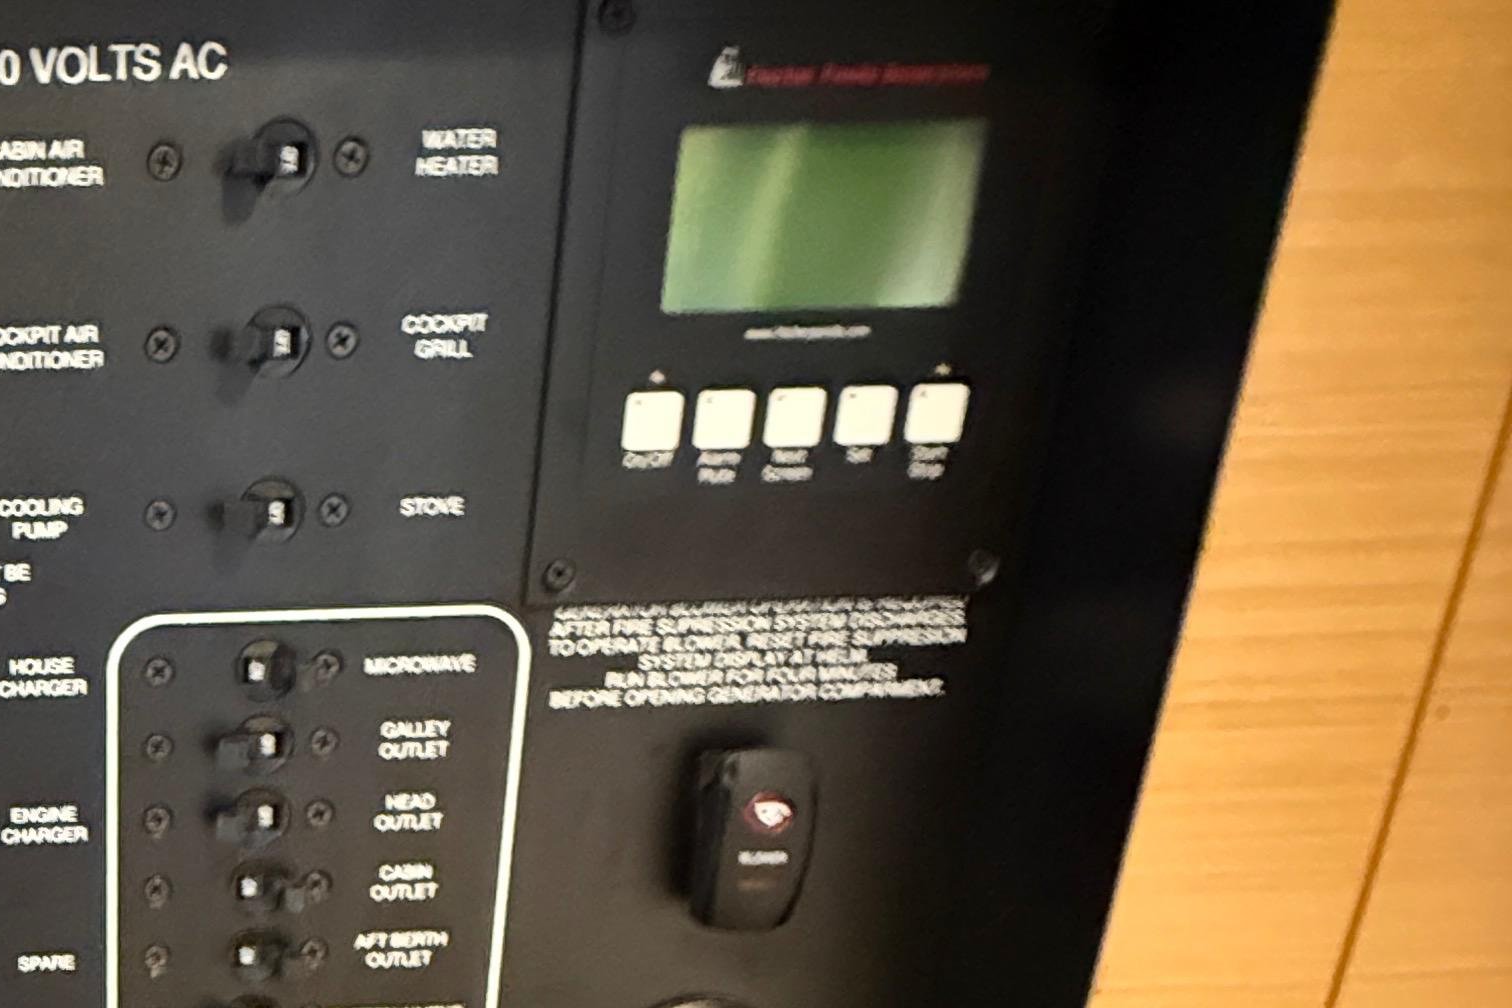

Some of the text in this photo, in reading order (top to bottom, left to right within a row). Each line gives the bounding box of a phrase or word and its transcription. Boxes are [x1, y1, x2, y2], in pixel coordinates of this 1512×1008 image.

[29, 43, 162, 85] VOLTS
[168, 41, 228, 81] AC
[47, 138, 85, 160] AIR
[422, 128, 497, 150] WATER
[415, 154, 499, 177] HEATER
[63, 324, 99, 344] AIR
[401, 312, 489, 335] COCKPIT
[414, 338, 473, 359] GRILL
[399, 495, 465, 517] STOVE
[11, 520, 69, 540] PUMP
[3, 562, 31, 582] BE
[8, 656, 75, 676] HOUSE
[363, 653, 477, 675] MICROWAVE
[380, 719, 451, 740] GALLEY
[378, 739, 450, 761] OUTLET
[384, 792, 437, 811] HEAD
[9, 805, 78, 825] ENGINE
[373, 811, 444, 832] OUTLET
[0, 825, 89, 845] CHARGER
[378, 863, 434, 882] CABIN
[369, 881, 439, 902] OUTLET
[353, 930, 449, 950] AFT BERTH
[17, 954, 76, 973] SPARE
[364, 949, 433, 969] OUTLET
